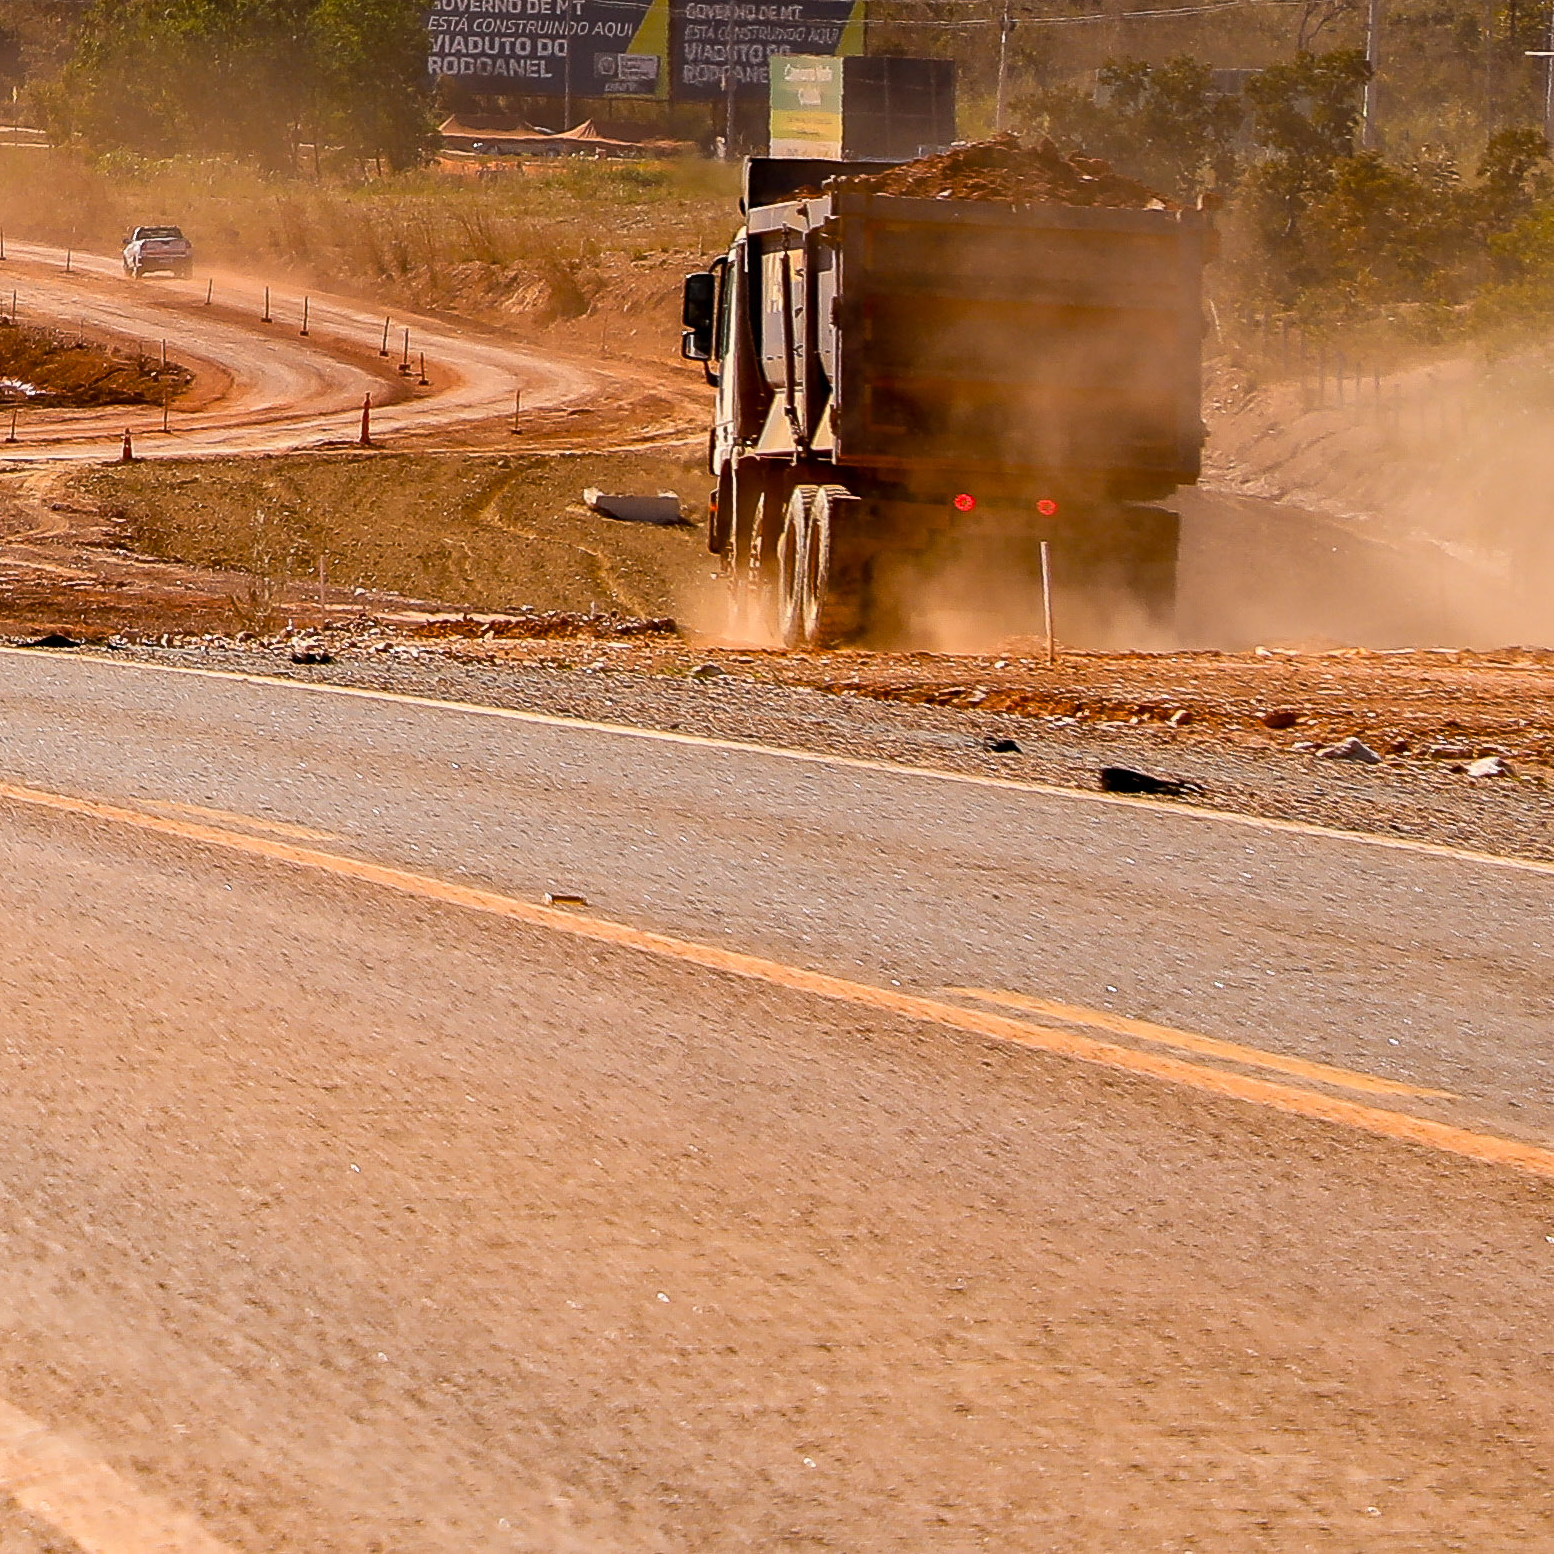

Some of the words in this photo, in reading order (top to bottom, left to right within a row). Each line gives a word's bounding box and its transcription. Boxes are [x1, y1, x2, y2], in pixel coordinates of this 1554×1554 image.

[556, 0, 585, 15] MT
[758, 5, 777, 20] DE
[780, 5, 803, 21] MT
[428, 14, 468, 32] ESTÁ
[473, 18, 589, 37] CONSTRUINDO
[592, 22, 633, 38] AQUI
[430, 34, 531, 56] VIADUTO
[537, 39, 568, 57] DO
[428, 56, 553, 78] RODOANEL
